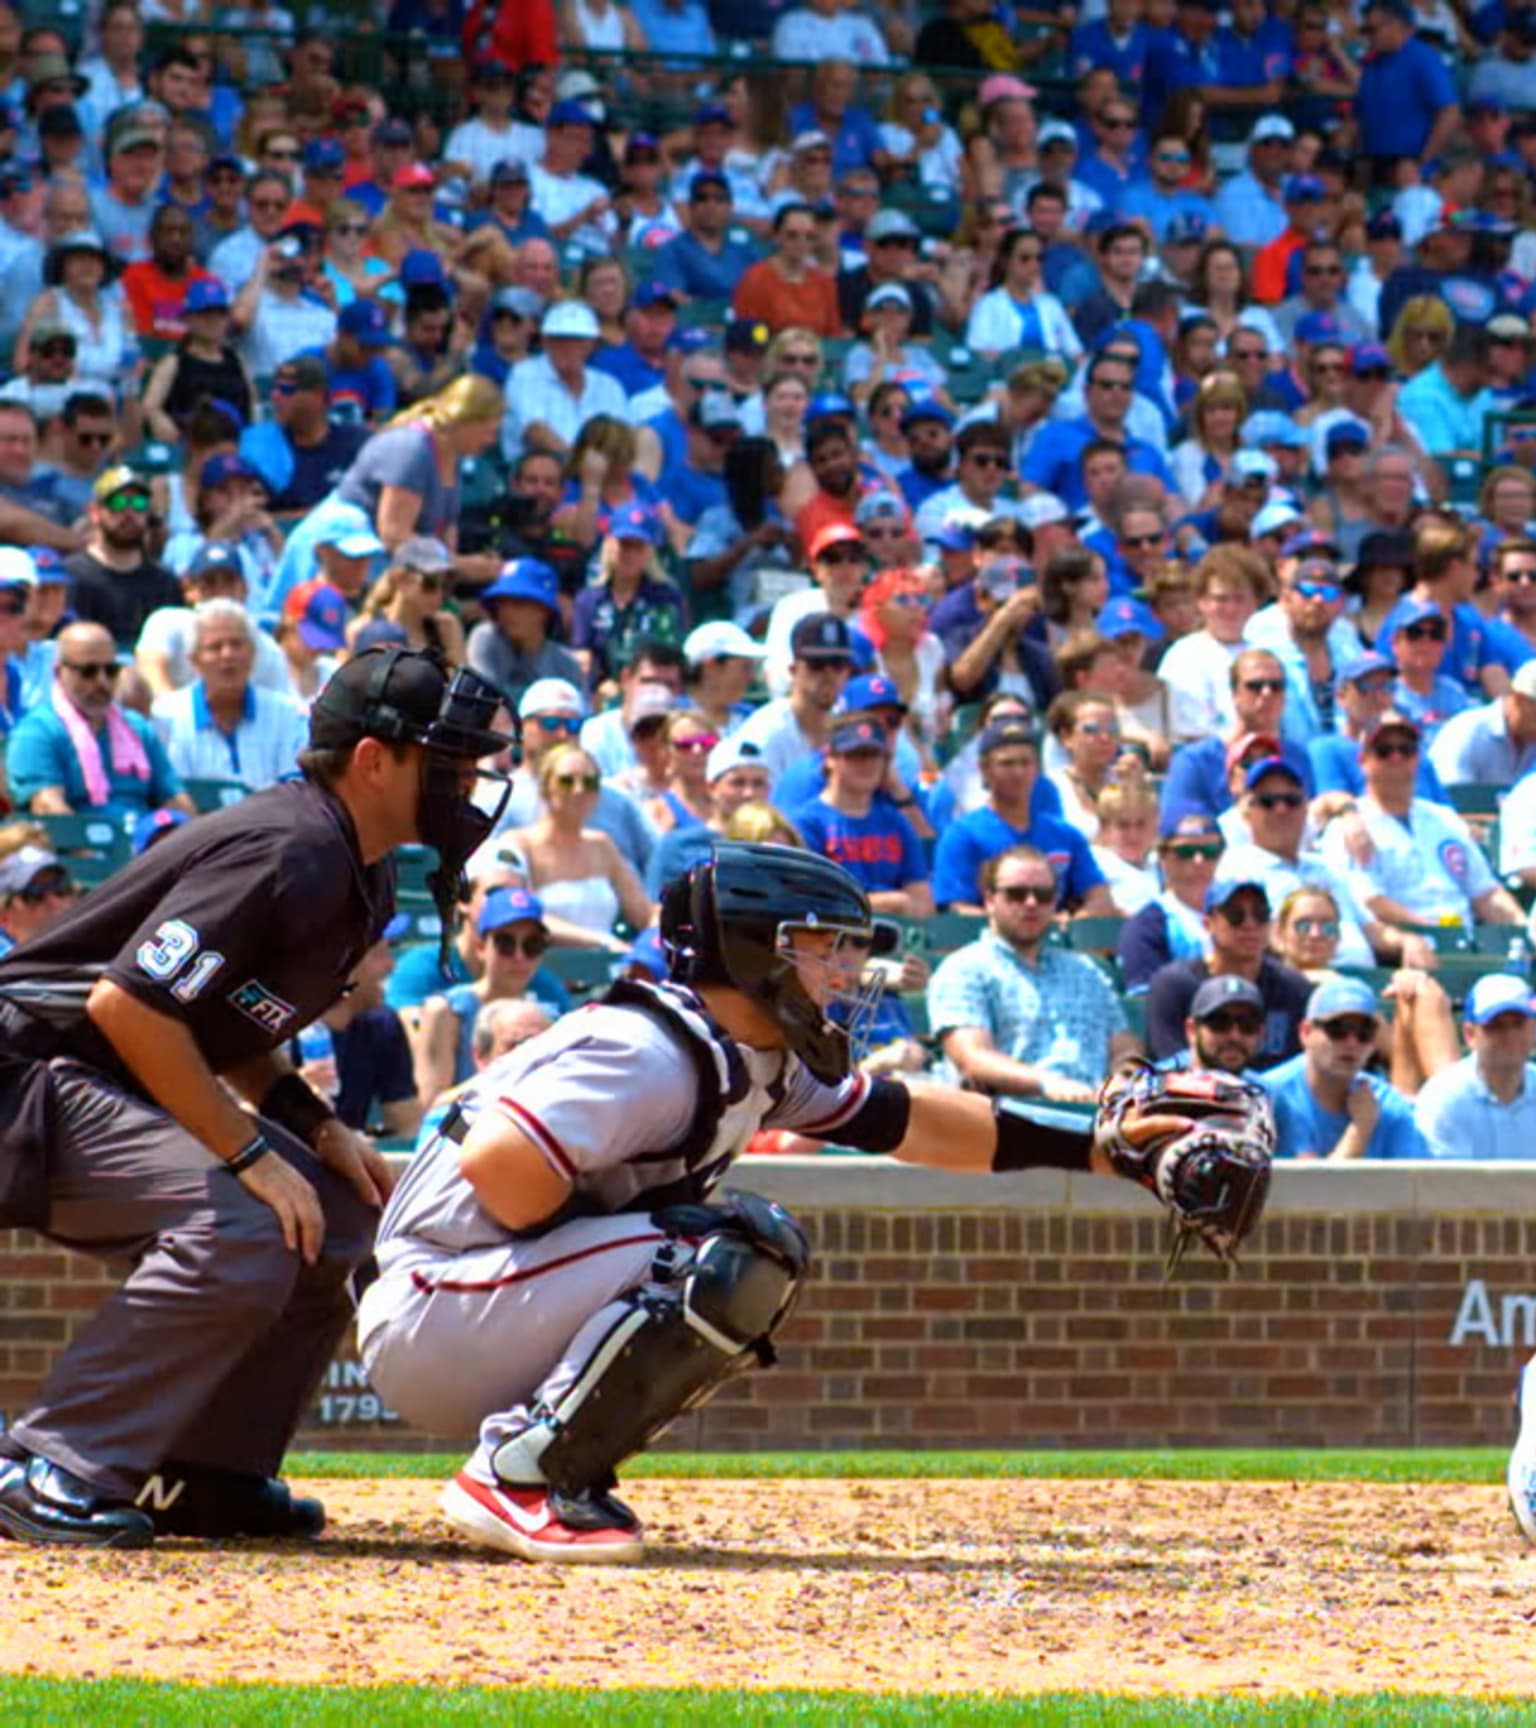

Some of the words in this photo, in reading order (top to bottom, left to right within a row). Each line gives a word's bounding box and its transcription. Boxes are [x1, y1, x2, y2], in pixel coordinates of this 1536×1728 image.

[136, 919, 226, 1004] 31
[250, 998, 294, 1031] FTX
[321, 1393, 400, 1422] 179
[133, 1474, 186, 1511] N
